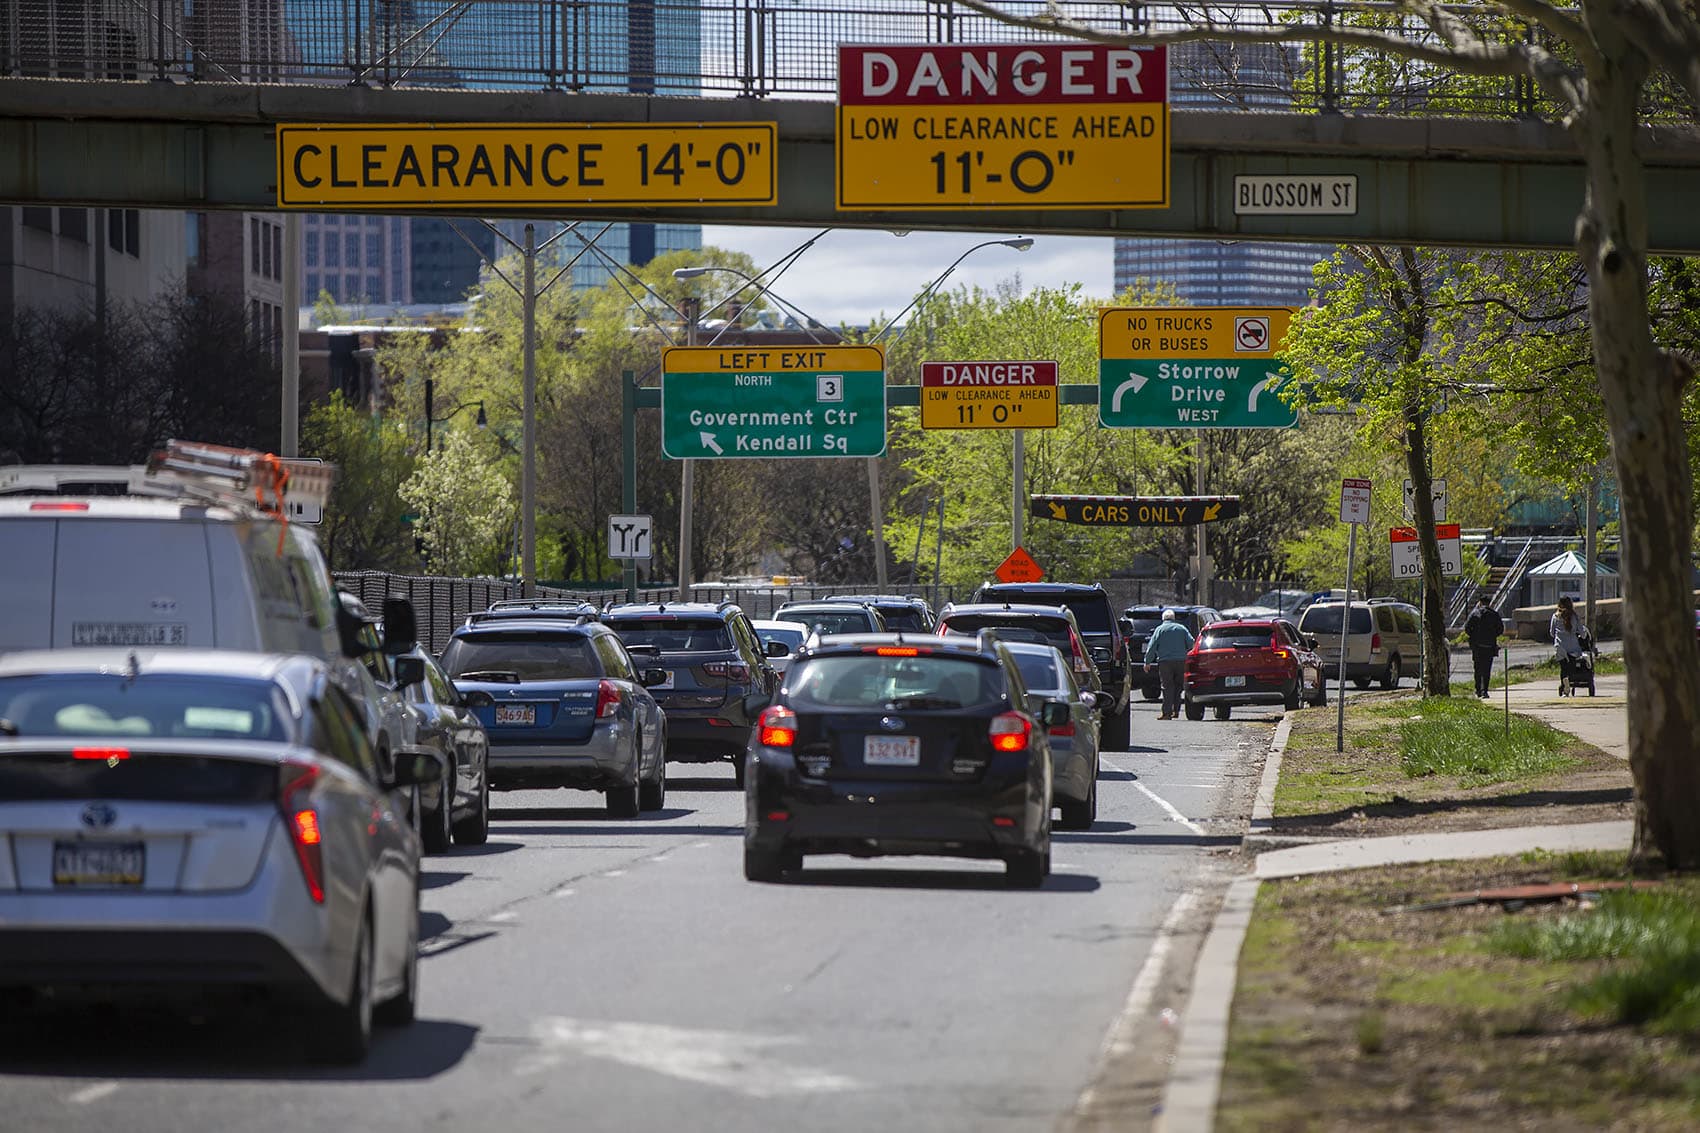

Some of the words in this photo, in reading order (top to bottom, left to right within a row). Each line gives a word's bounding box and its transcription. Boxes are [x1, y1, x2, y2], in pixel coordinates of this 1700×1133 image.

[862, 50, 1143, 97] DANGER
[850, 117, 899, 140] LOW
[914, 115, 1058, 140] CLEARANCE
[1072, 115, 1155, 138] AHEAD
[293, 143, 604, 188] CLEARANCE
[637, 142, 761, 187] 14'-0"
[1240, 183, 1322, 207] BLOSSOM
[1332, 183, 1352, 207] ST
[1127, 318, 1149, 331] NO
[1156, 317, 1213, 331] TRUCKS
[1131, 338, 1153, 351] OR
[1159, 337, 1209, 351] BUSES
[719, 353, 770, 369] LEFT
[781, 352, 827, 368] EXIT
[735, 374, 772, 386] NORTH
[943, 365, 1036, 385] DANGER
[1158, 363, 1240, 380] Storrow
[824, 381, 836, 396] 3
[928, 390, 953, 401] LOW
[956, 389, 1011, 400] CLEARANCE
[1019, 388, 1051, 399] AHEAD
[1171, 384, 1226, 402] Drive
[690, 409, 813, 426] Government
[824, 409, 858, 425] Ctr
[1177, 407, 1219, 421] WEST
[736, 434, 812, 451] Kendall
[823, 434, 848, 454] Sq
[1082, 505, 1129, 523] CARS
[1139, 506, 1187, 523] ONLY
